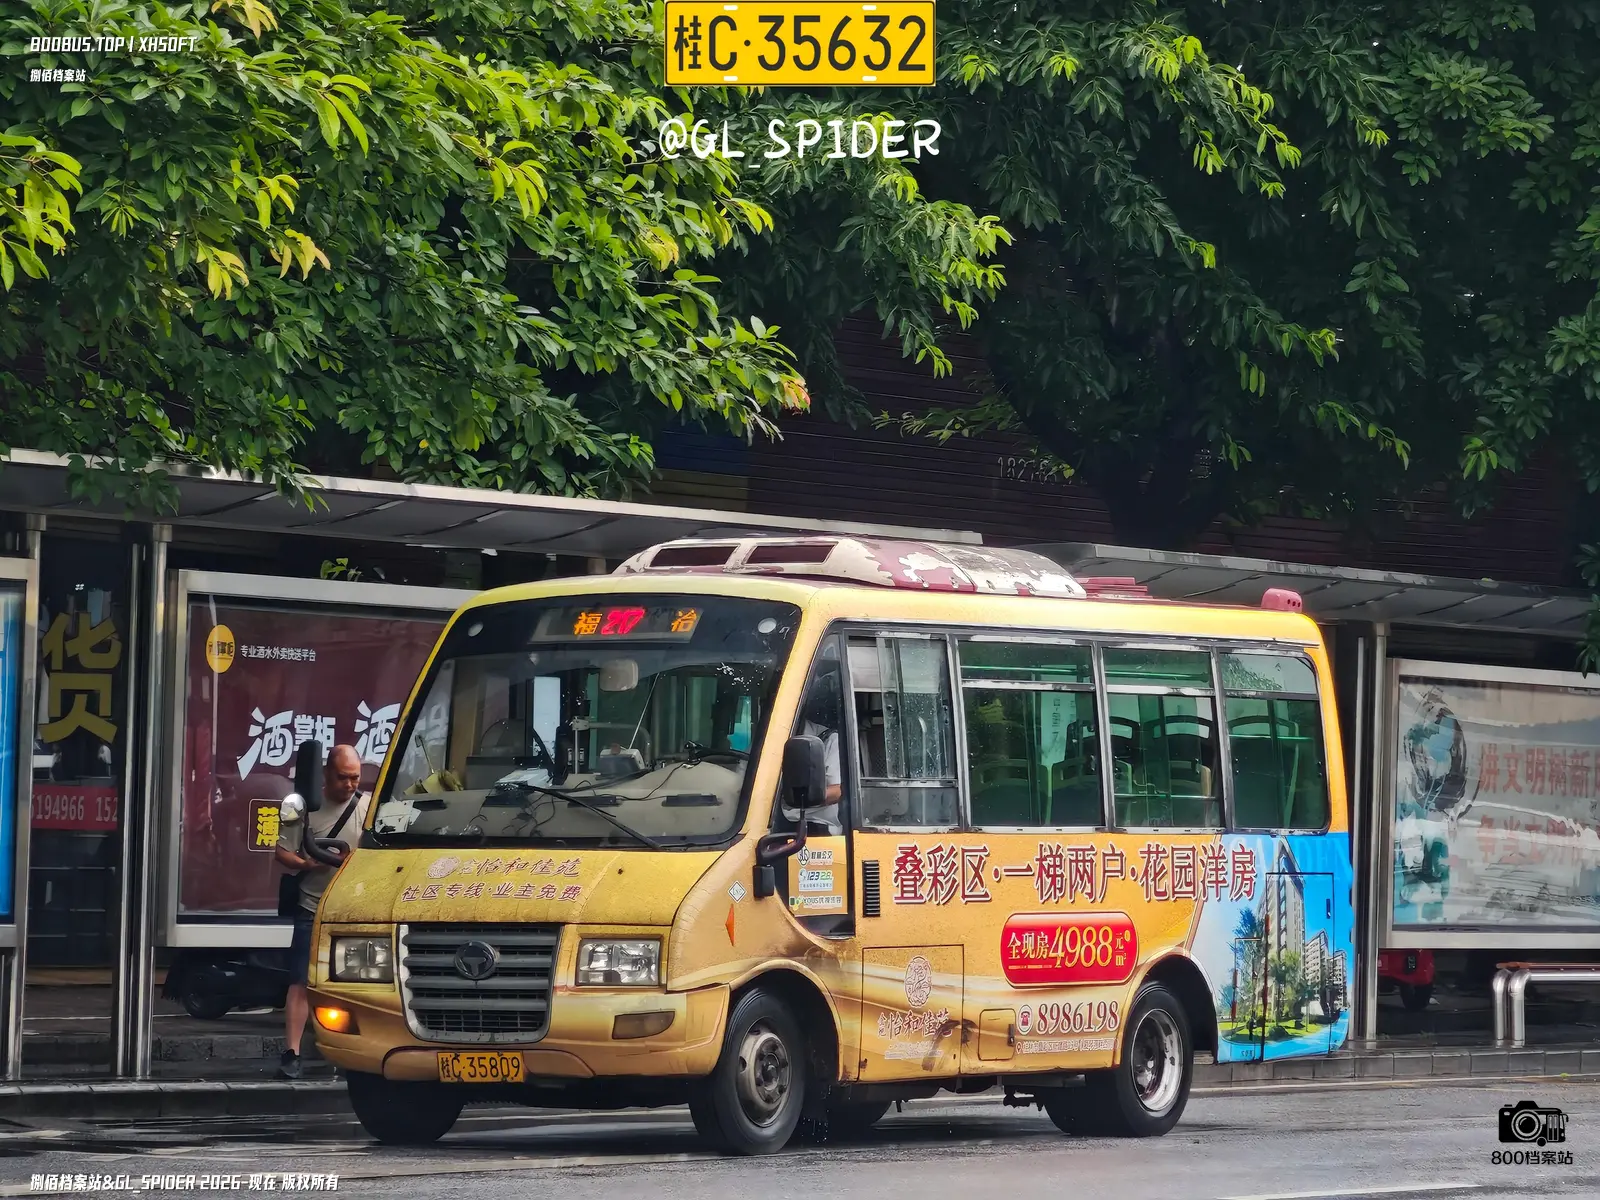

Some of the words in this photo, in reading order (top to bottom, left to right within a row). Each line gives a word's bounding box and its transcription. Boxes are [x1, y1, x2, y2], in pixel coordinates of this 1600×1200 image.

[240, 644, 317, 662] 专业酒水外卖快送平台
[41, 612, 122, 744] 货
[893, 842, 1258, 905] 叠彩区·一梯两户·花园洋房
[402, 882, 583, 902] 社区专线·业主免费
[1036, 1000, 1119, 1035] 8986198
